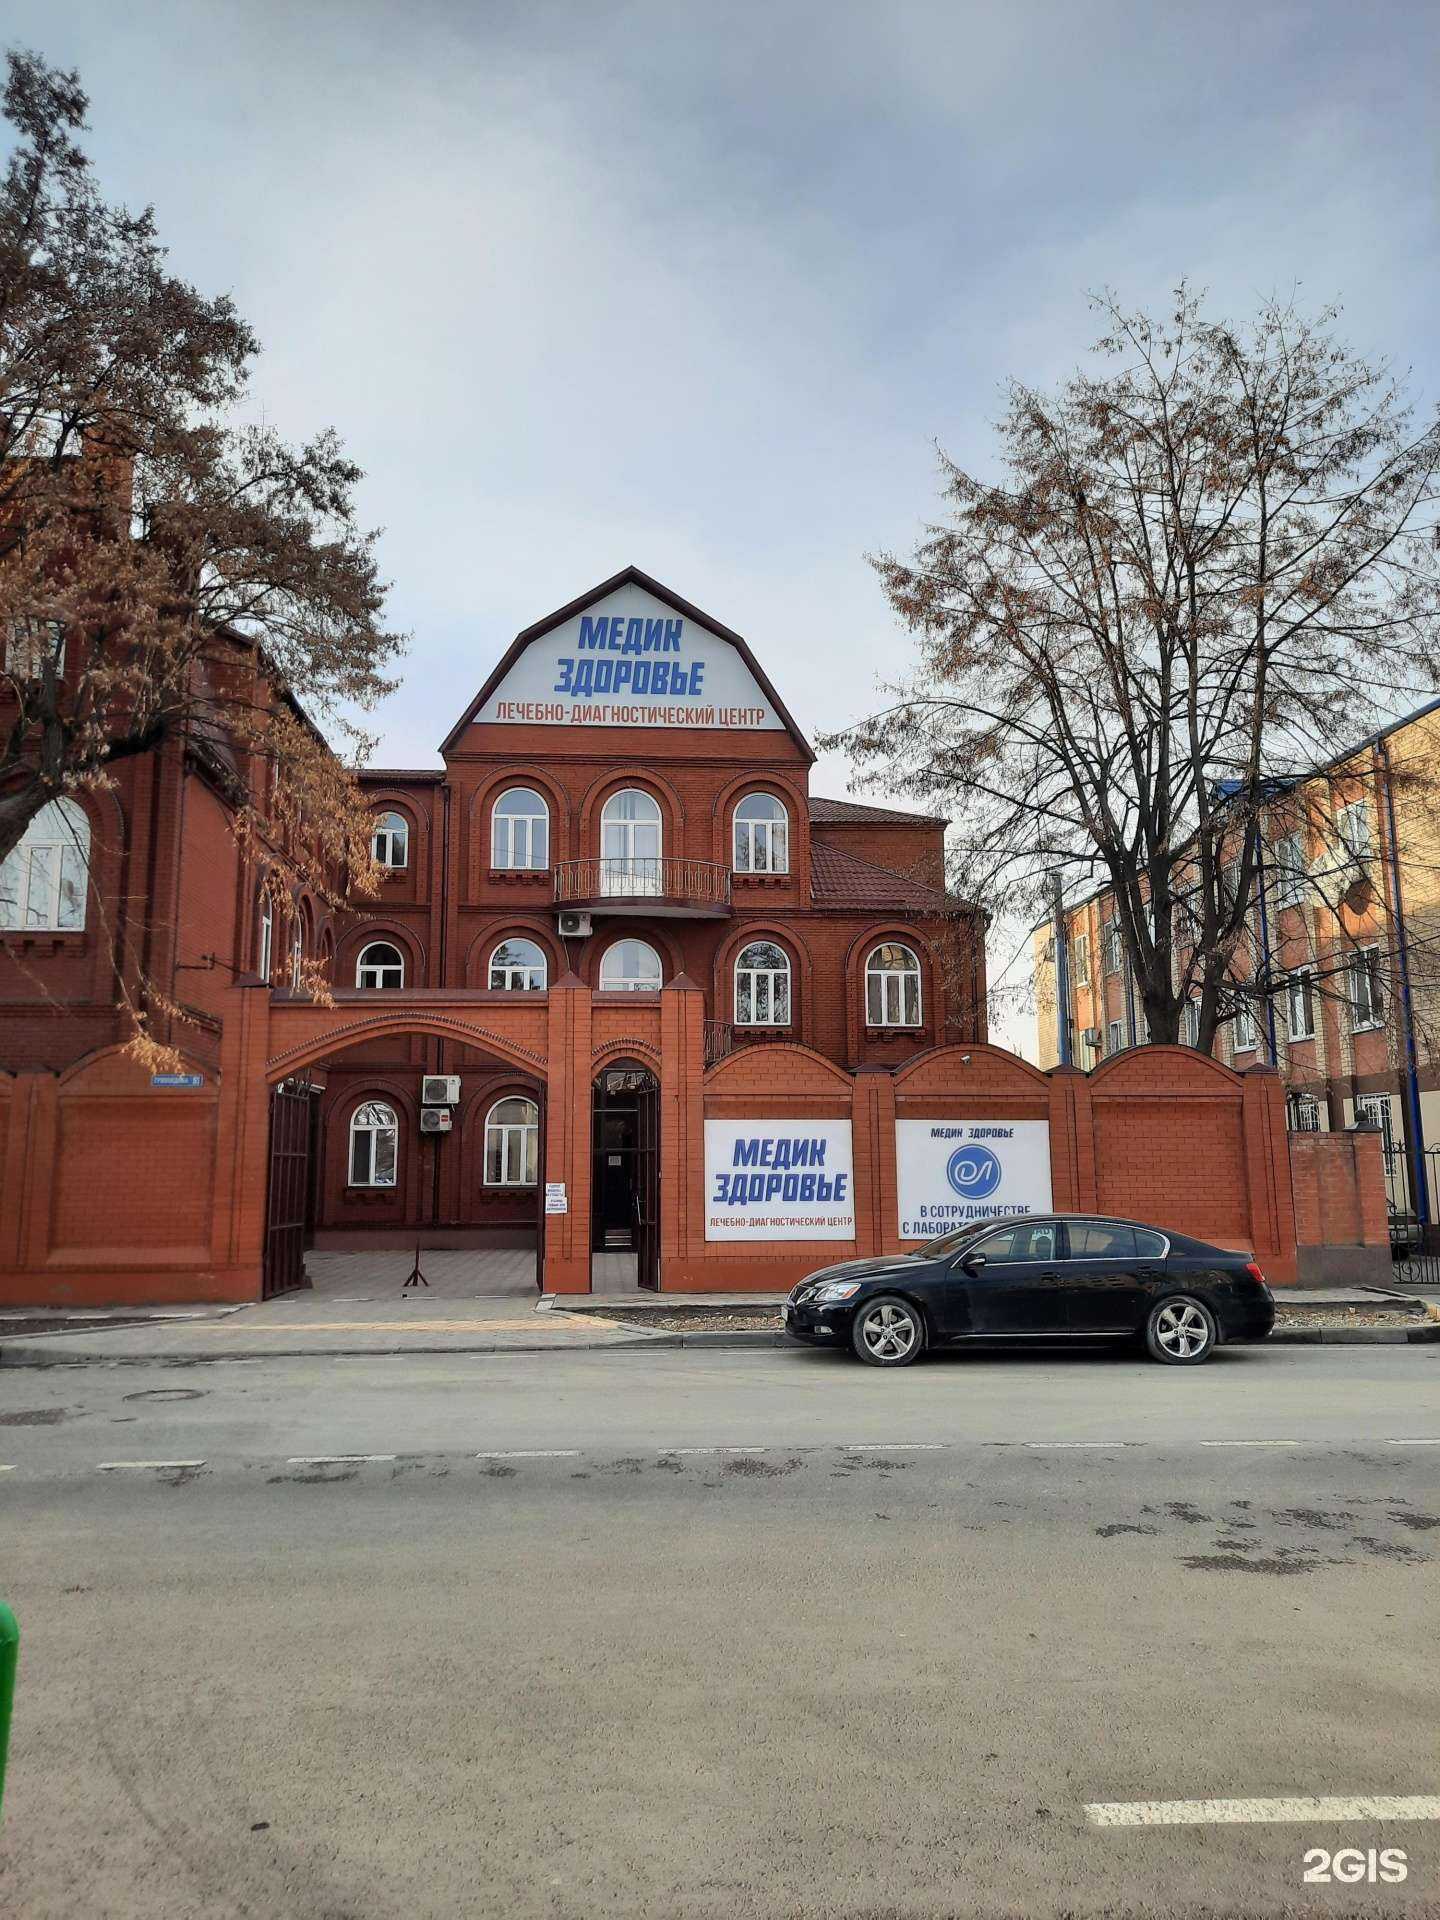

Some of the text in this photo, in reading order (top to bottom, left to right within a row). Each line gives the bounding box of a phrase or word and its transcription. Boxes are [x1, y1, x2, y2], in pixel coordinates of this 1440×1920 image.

[578, 616, 683, 655] МЕДИК
[554, 658, 705, 697] ЗДОРОВЬЕ
[496, 702, 765, 726] ЛЕЧЕБНО-ДИАГНОСТИЧЕСКИЙ ЦЕНТР
[931, 1128, 1014, 1139] МЕДИК ЗДОРОВЬЕ
[732, 1138, 827, 1170] МЕДИК
[712, 1173, 848, 1206] ЗДОРОВЬЕ
[710, 1217, 853, 1227] ЛЕЧЕБНО-ДИАГНОСТИЧЕСКИЙ ЦЕНТР
[920, 1205, 1031, 1219] В СОТРУДНИЧЕСТВЕ
[902, 1221, 910, 1234] С
